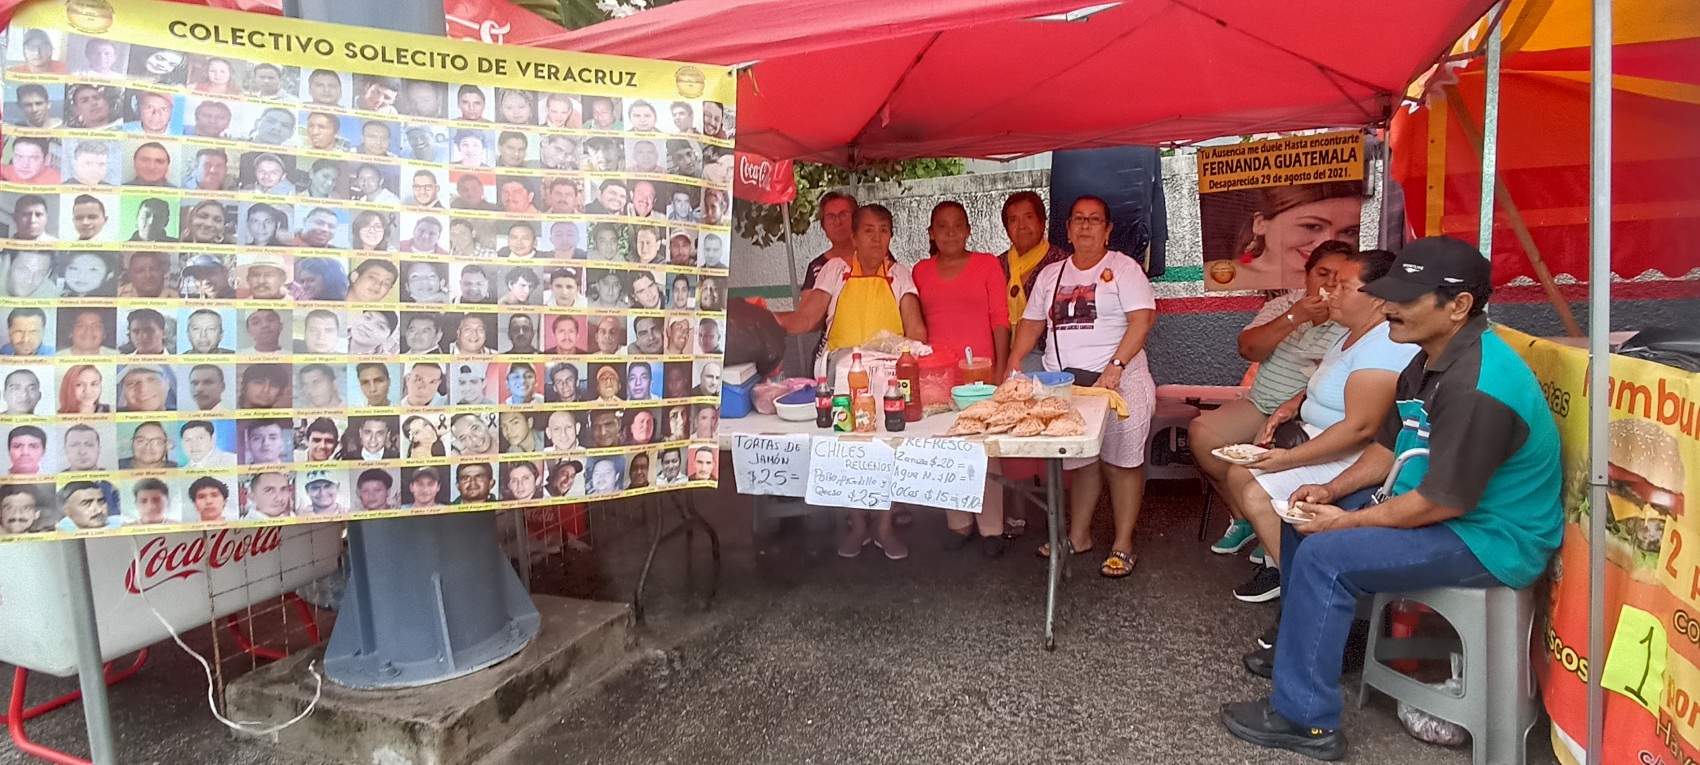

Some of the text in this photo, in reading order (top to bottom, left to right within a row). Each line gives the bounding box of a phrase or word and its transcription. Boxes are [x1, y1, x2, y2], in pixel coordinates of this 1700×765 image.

[168, 20, 638, 87] COLECTIVO SOLECITO DE VERACRUZ
[1201, 134, 1360, 160] Tu Ausencia me duele Hasta encontrarte
[1202, 146, 1358, 178] FERNANDA GUATEMALA
[1208, 167, 1351, 193] Desaparecida 29 de agosto del 2021.
[735, 435, 779, 451] TORTAS
[814, 440, 866, 459] CHILES
[905, 437, 972, 452] REFRESCO
[748, 452, 789, 465] JAMÓN
[893, 465, 919, 481] Agua
[1624, 626, 1654, 706] 1
